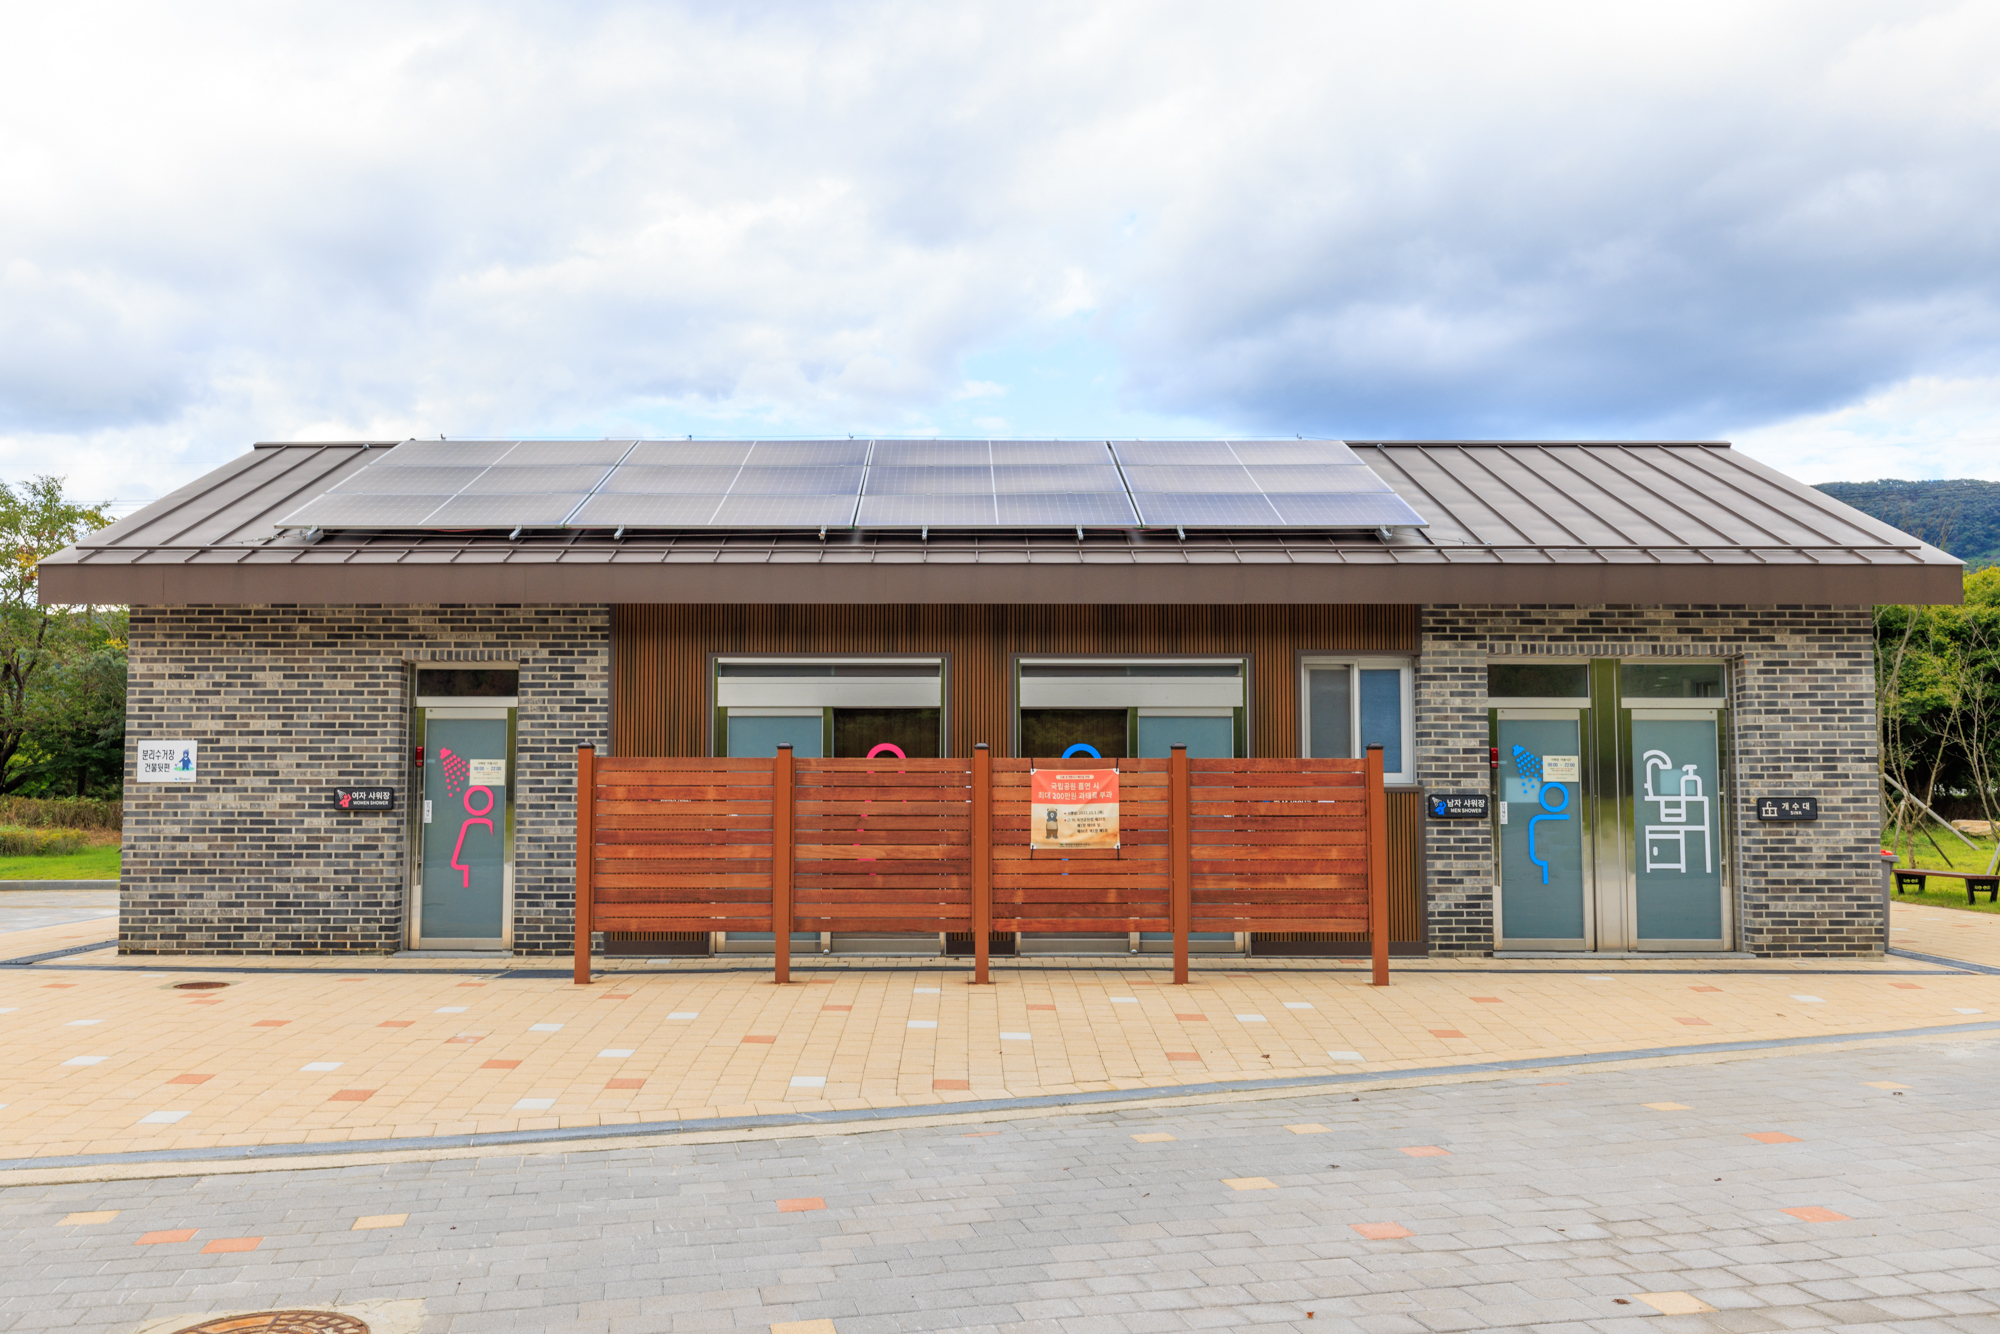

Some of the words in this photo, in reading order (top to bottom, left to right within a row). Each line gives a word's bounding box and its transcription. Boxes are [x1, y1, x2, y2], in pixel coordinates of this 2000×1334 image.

[142, 749, 175, 761] 분리수거장
[1051, 782, 1076, 791] 국립공원
[1078, 782, 1091, 791] 흡연
[1093, 782, 1099, 790] 시
[352, 791, 366, 800] 여자
[368, 791, 390, 800] 샤워장
[1038, 791, 1051, 799] 최대
[1052, 792, 1077, 800] 200만원
[1079, 791, 1097, 800] 과태료
[1099, 791, 1113, 799] 부과
[1446, 799, 1461, 807] 남자
[1463, 799, 1485, 807] 샤워장
